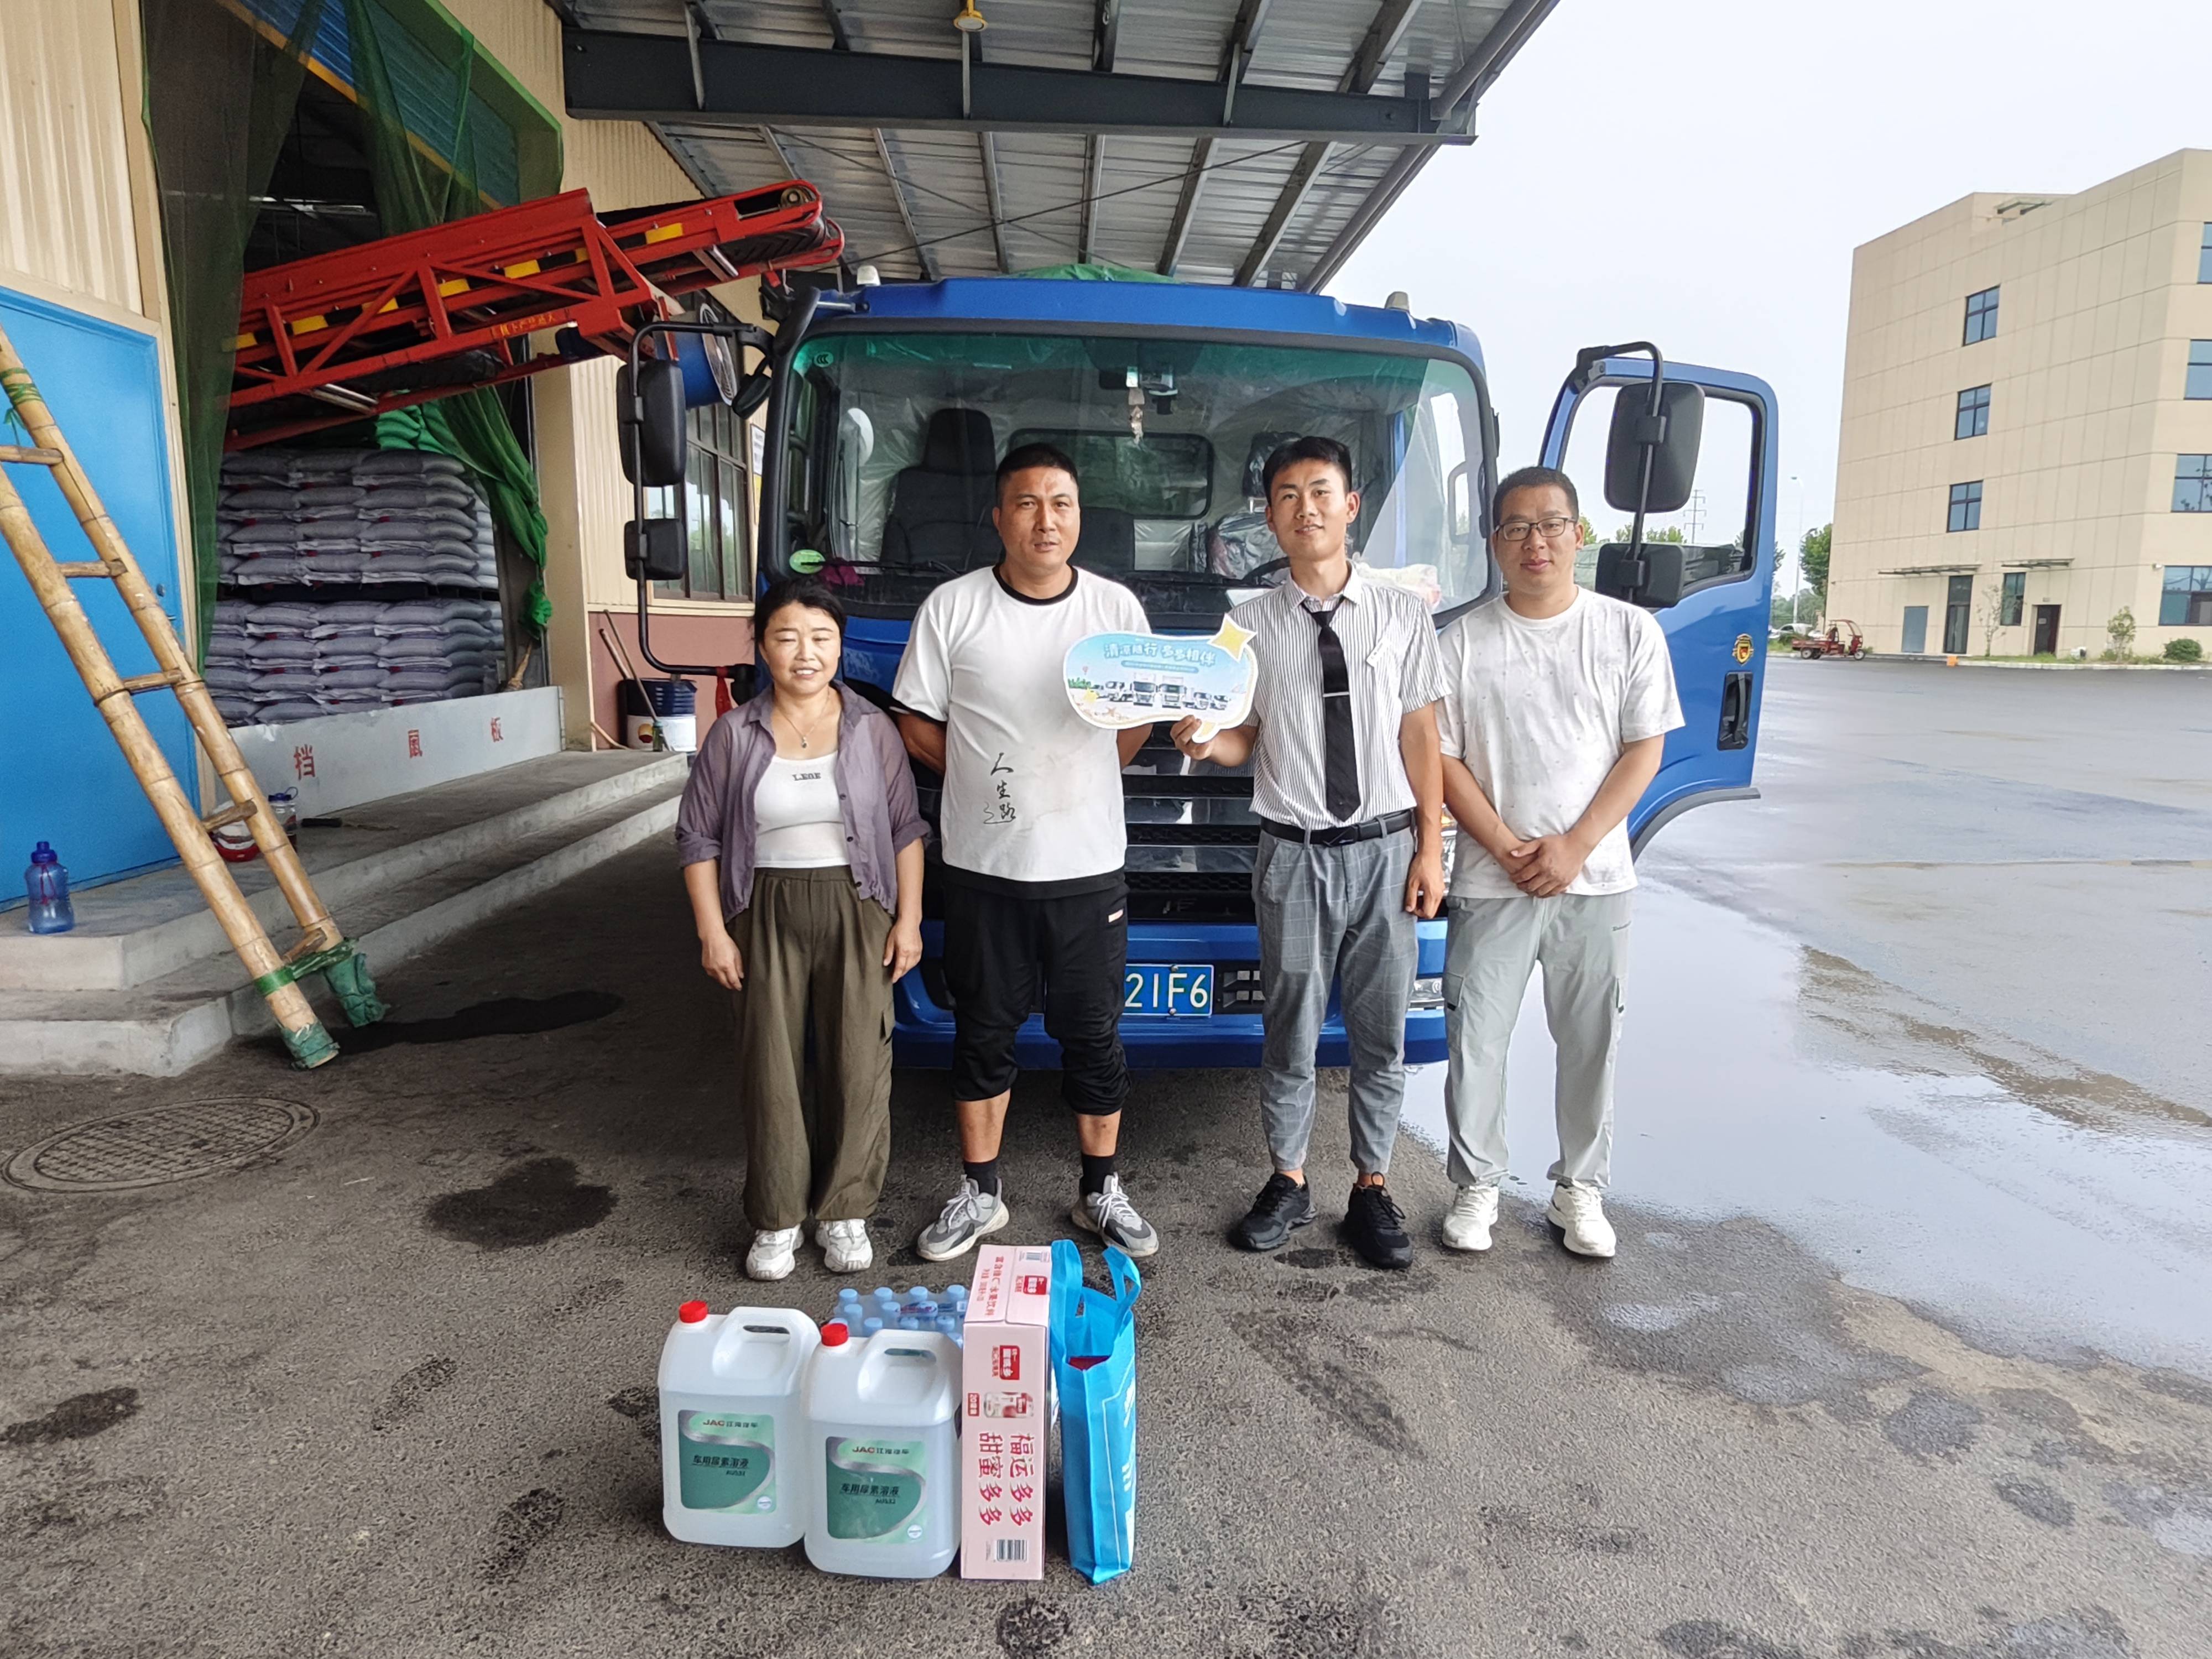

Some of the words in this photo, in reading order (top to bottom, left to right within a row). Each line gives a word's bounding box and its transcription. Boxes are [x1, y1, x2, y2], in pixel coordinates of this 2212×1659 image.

[1161, 645, 1216, 667] 多多相伴
[293, 744, 316, 781] 挡
[978, 1432, 1004, 1526] 甜蜜多多
[1010, 1433, 1035, 1526] 福运多多
